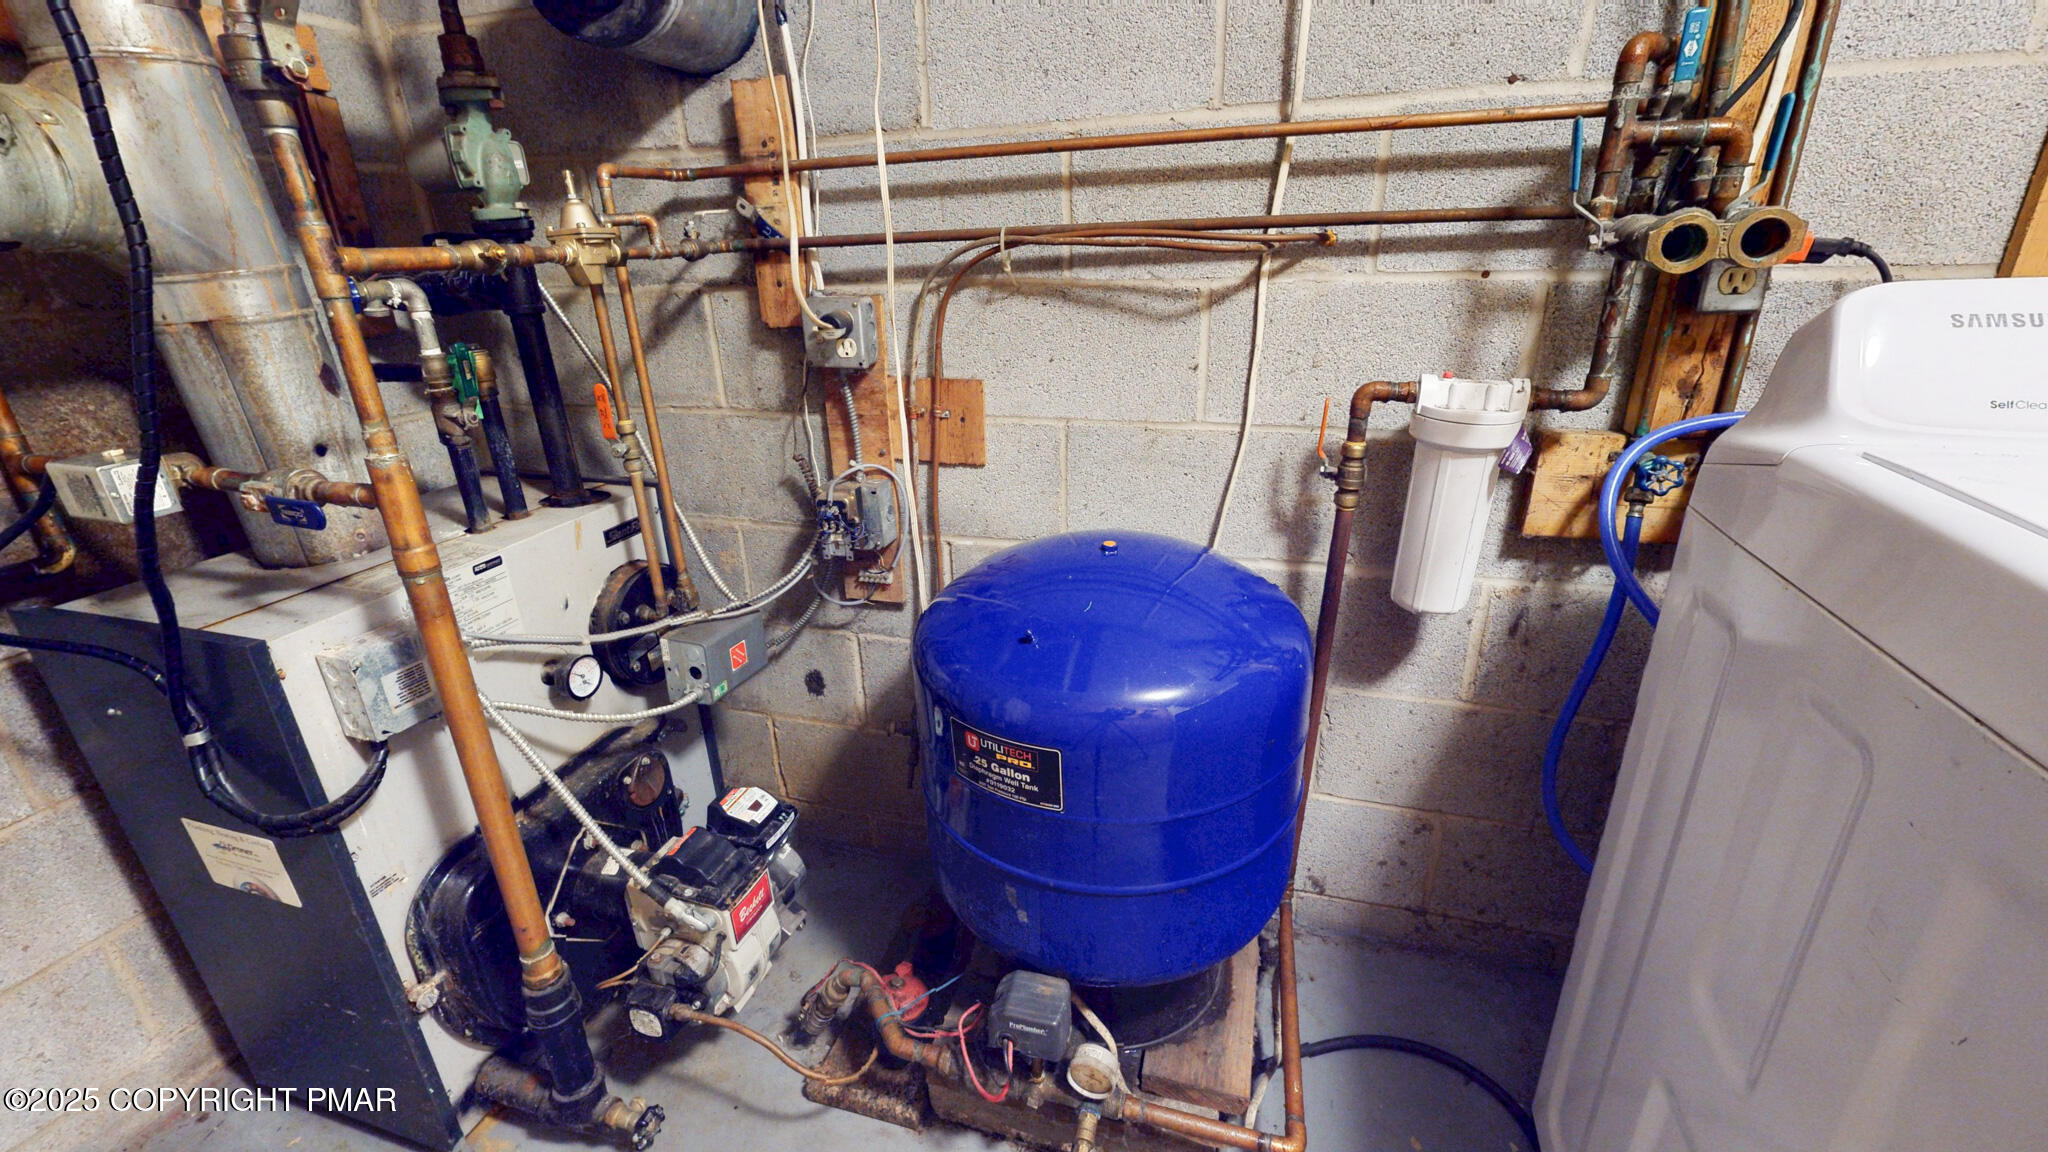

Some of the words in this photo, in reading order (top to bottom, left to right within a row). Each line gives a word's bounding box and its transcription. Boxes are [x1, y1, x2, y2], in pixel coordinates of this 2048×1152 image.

[1950, 312, 2048, 328] SAMSU
[980, 738, 1031, 760] UTILITECH
[973, 755, 987, 768] 25
[991, 762, 1030, 782] Gallon
[996, 753, 1032, 769] PRO
[1004, 777, 1019, 788] Well
[1021, 782, 1039, 792] Tank
